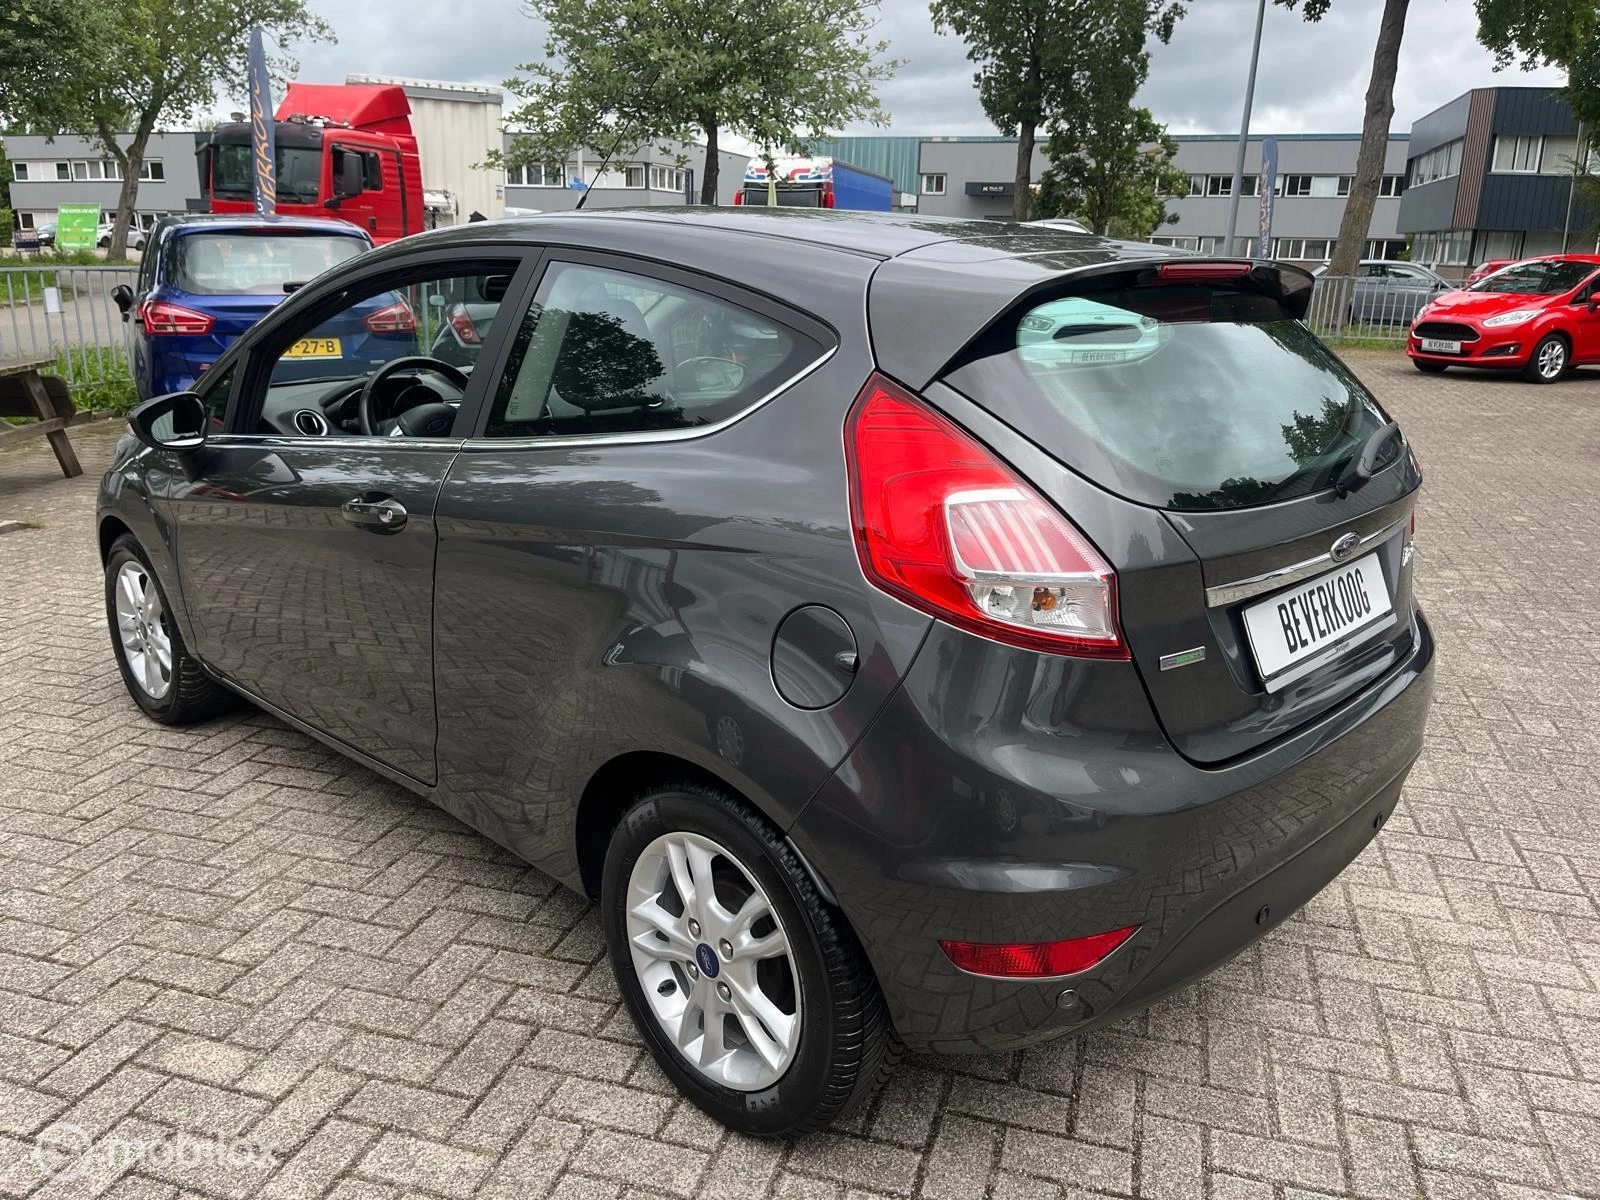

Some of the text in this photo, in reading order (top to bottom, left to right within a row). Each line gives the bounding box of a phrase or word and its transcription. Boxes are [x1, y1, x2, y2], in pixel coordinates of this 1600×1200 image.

[287, 340, 335, 354] -27-B
[1428, 340, 1454, 350] BEVERKOOG
[1081, 350, 1117, 362] BEVERKOOG
[1277, 567, 1371, 654] BEVERKOOG
